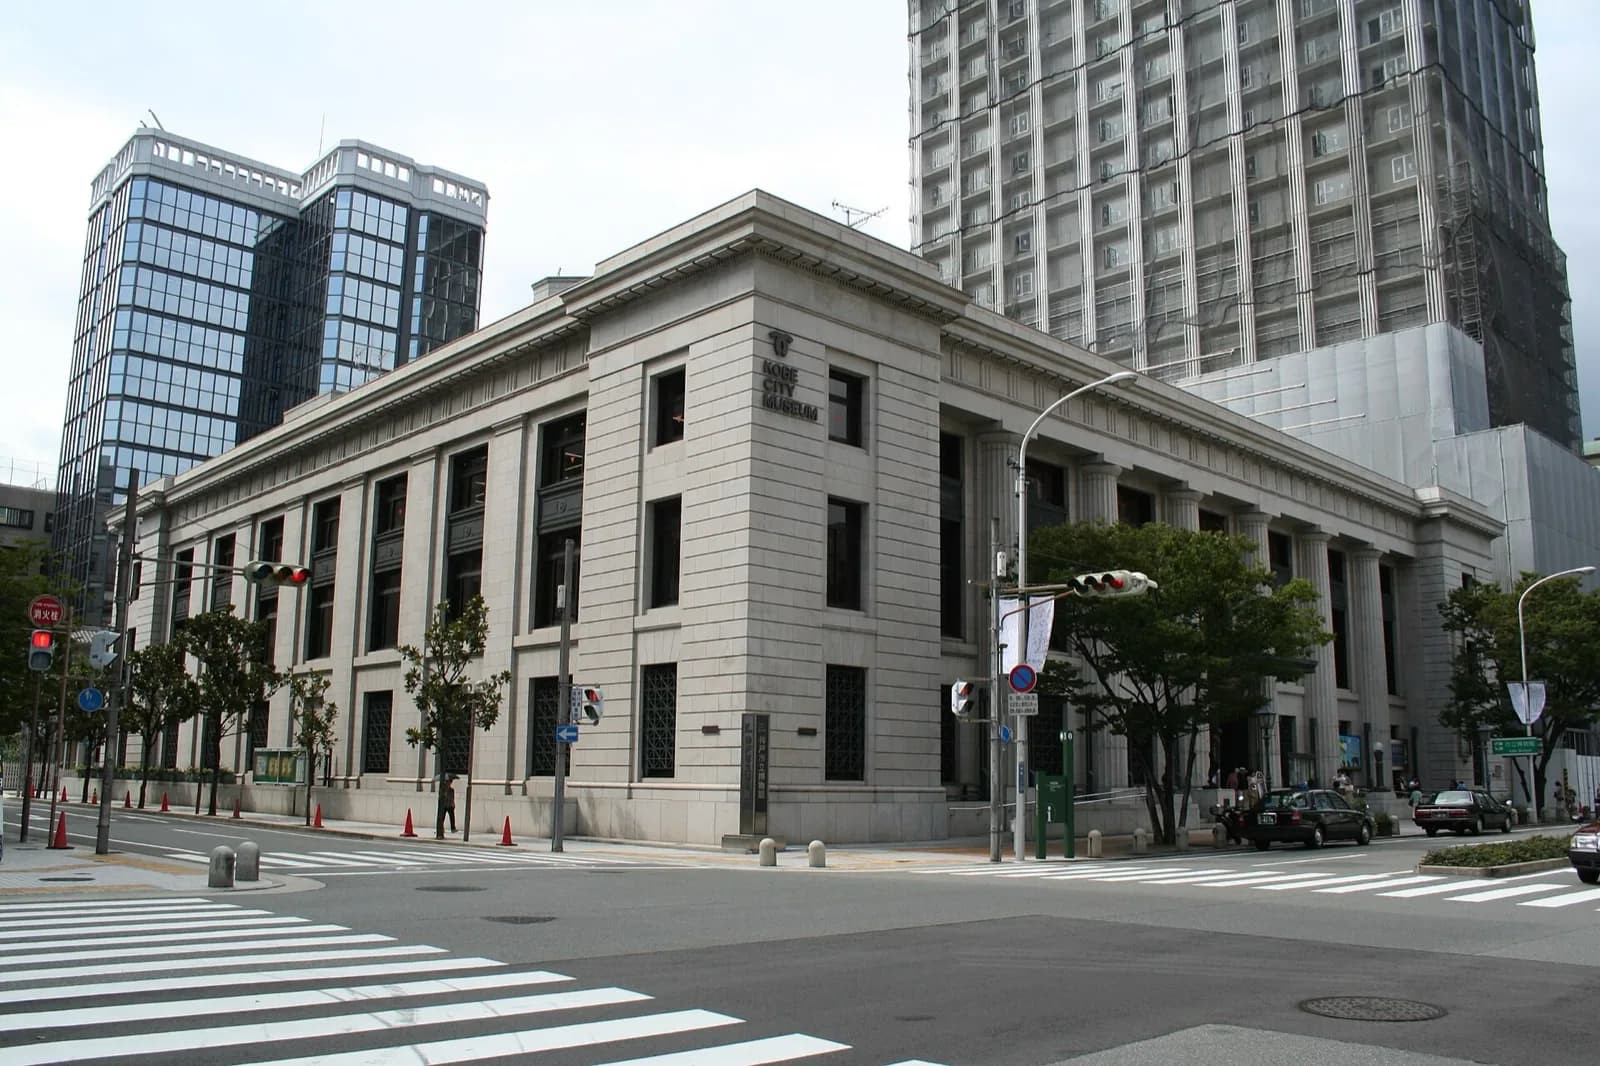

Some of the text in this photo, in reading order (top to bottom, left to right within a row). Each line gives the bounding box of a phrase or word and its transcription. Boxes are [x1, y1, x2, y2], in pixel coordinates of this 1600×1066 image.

[763, 359, 799, 383] KOBE
[763, 378, 796, 398] CITY
[762, 392, 818, 421] MUSEUM
[34, 609, 58, 621] 消火栓
